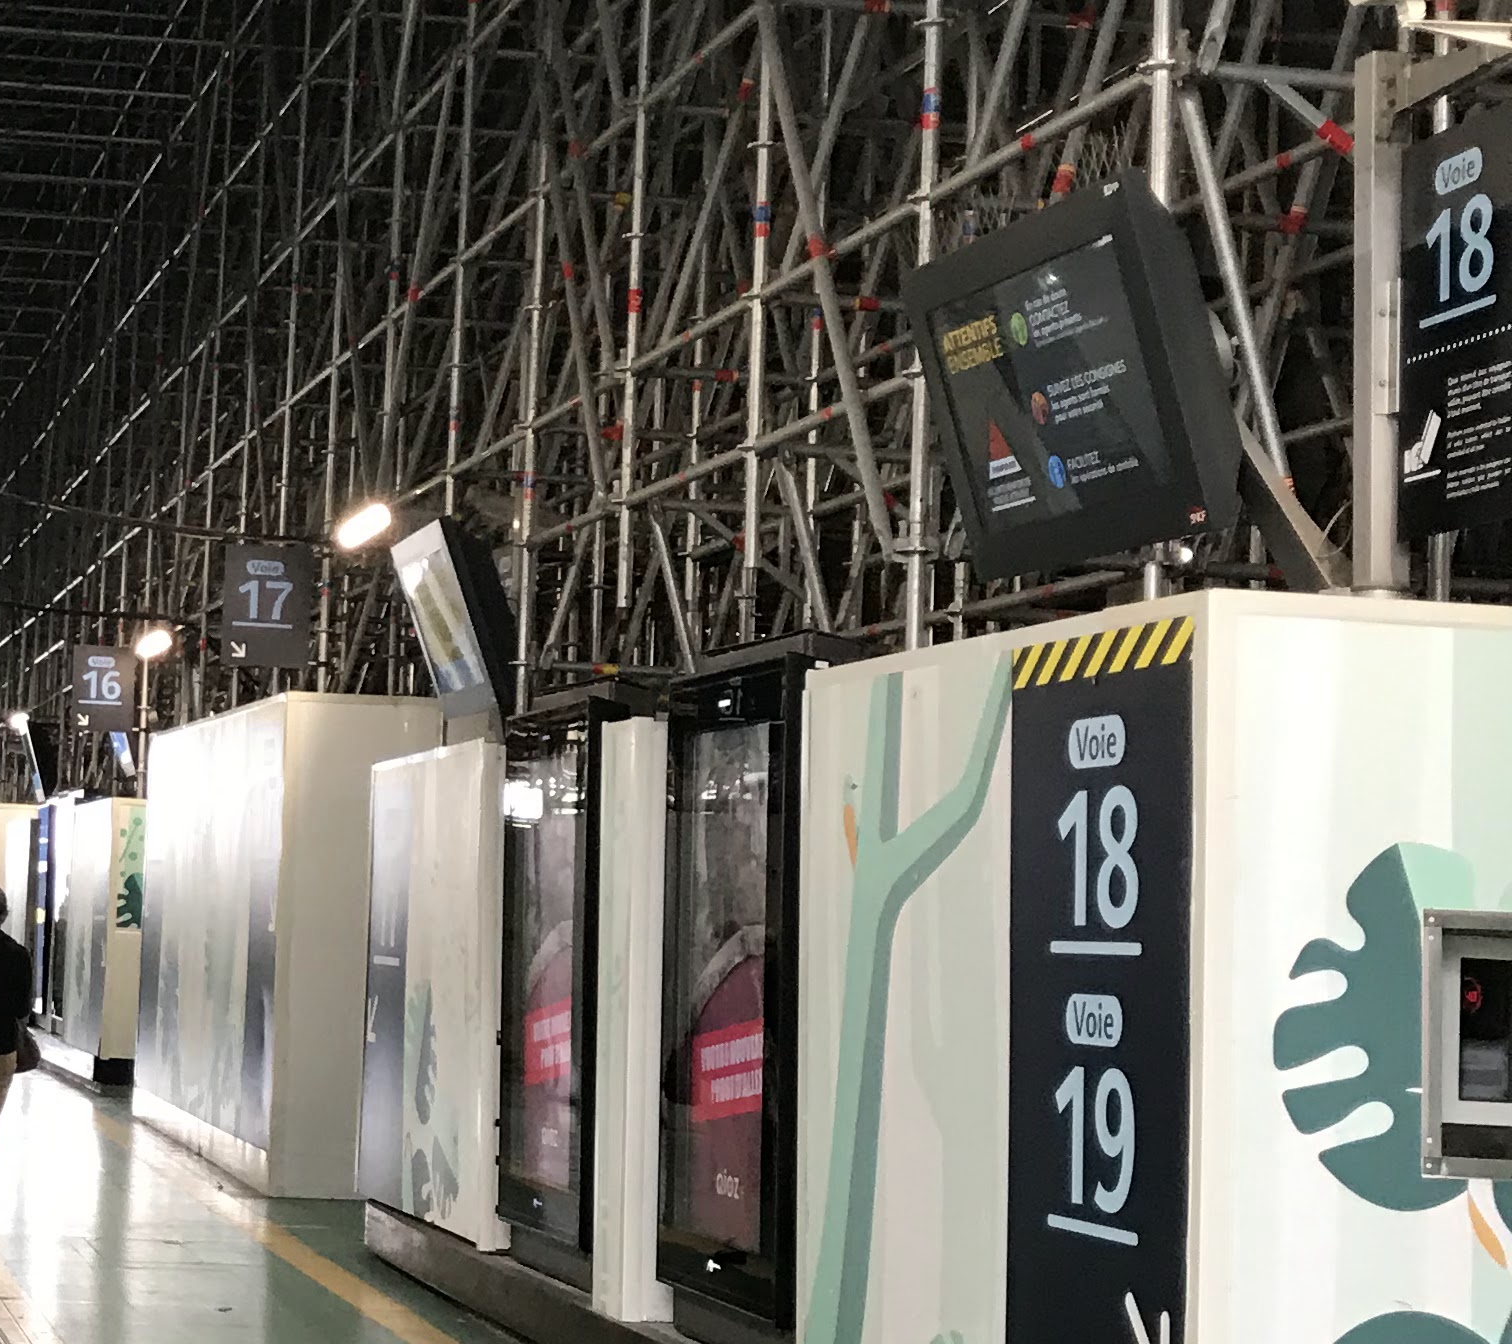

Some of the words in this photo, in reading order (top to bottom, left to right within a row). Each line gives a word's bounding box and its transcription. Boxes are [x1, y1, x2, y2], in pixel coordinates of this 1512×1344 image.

[1441, 157, 1476, 189] Voie
[1425, 193, 1495, 303] 18
[238, 579, 294, 621] 17
[82, 670, 122, 700] 16
[1076, 721, 1118, 763] Voie
[1057, 784, 1140, 931] 18
[1073, 999, 1116, 1043] Voie
[1055, 1064, 1137, 1215] 19
